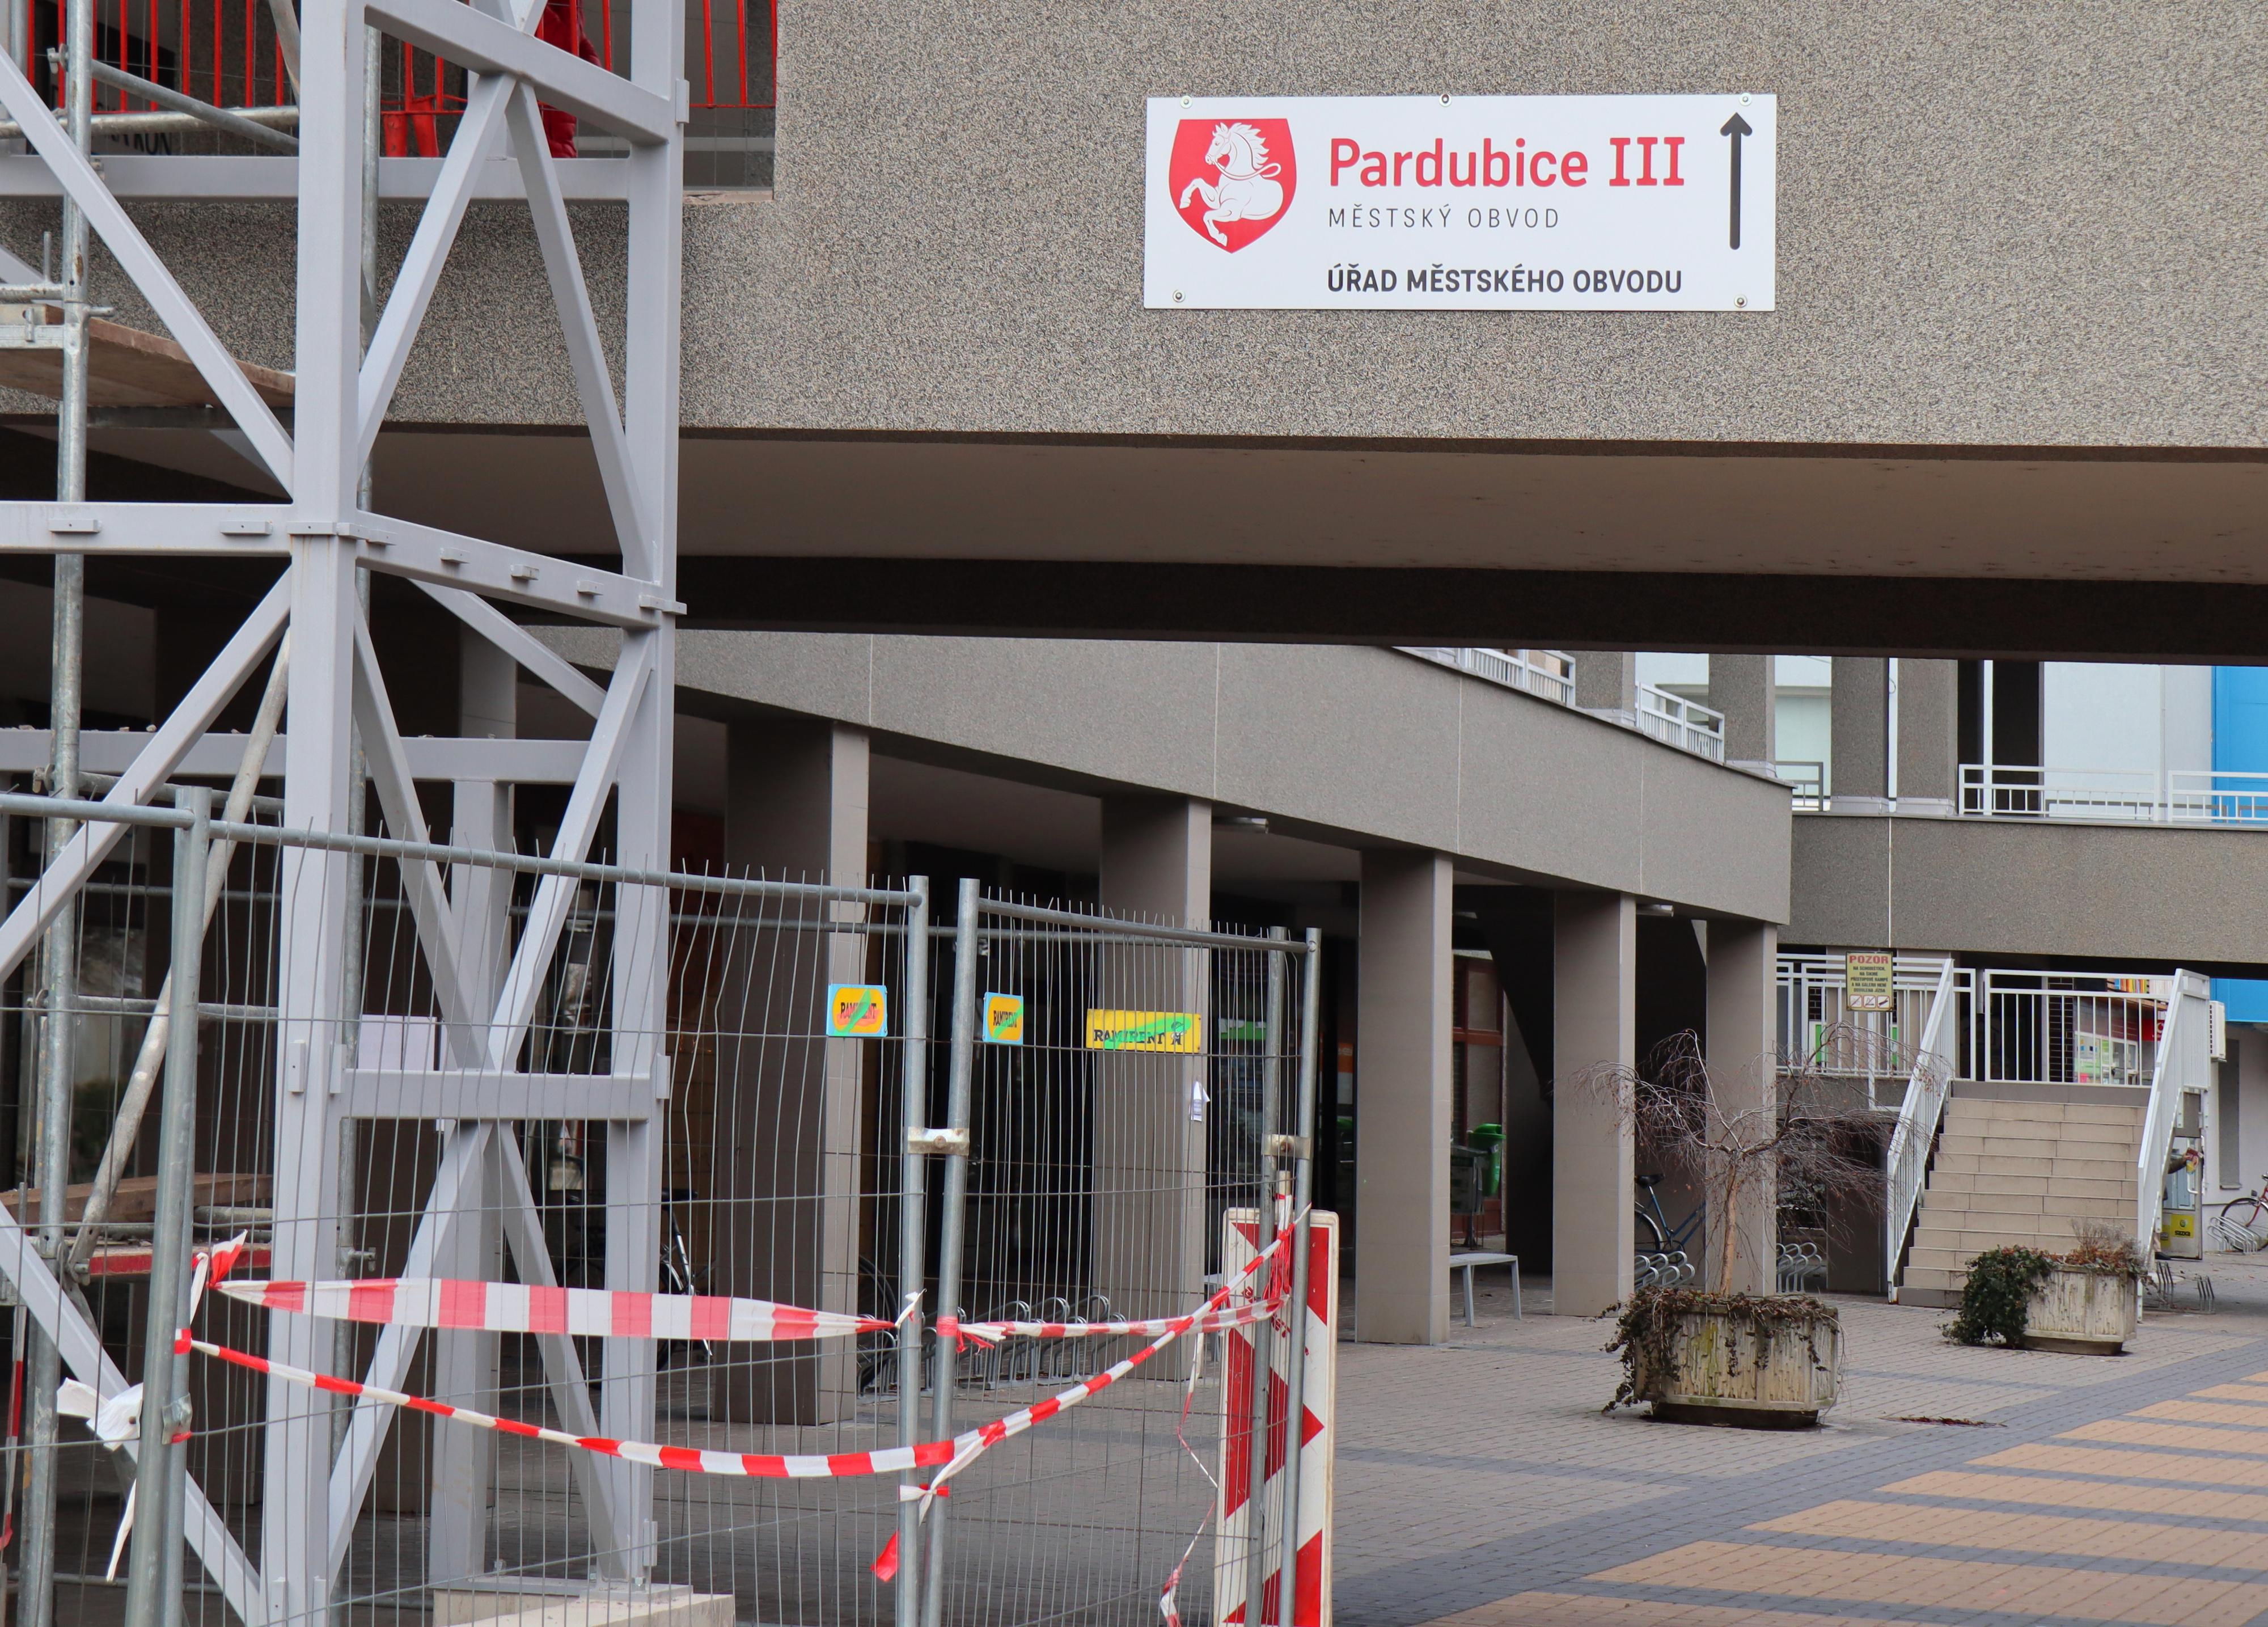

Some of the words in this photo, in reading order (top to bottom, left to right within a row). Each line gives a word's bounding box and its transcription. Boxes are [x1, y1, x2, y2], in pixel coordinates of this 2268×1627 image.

[1330, 138, 1588, 187] Pardubice
[1609, 137, 1685, 187] III
[1329, 204, 1451, 228] MĚSTSKÝ
[1468, 208, 1558, 228] OBVOD
[1328, 263, 1397, 293] ÚŘAD
[1407, 263, 1564, 293] MĚSTSKÉHO
[1573, 269, 1682, 293] OBVODU
[1849, 955, 1889, 964] POZOR
[1094, 1029, 1165, 1044] RAMIRENT
